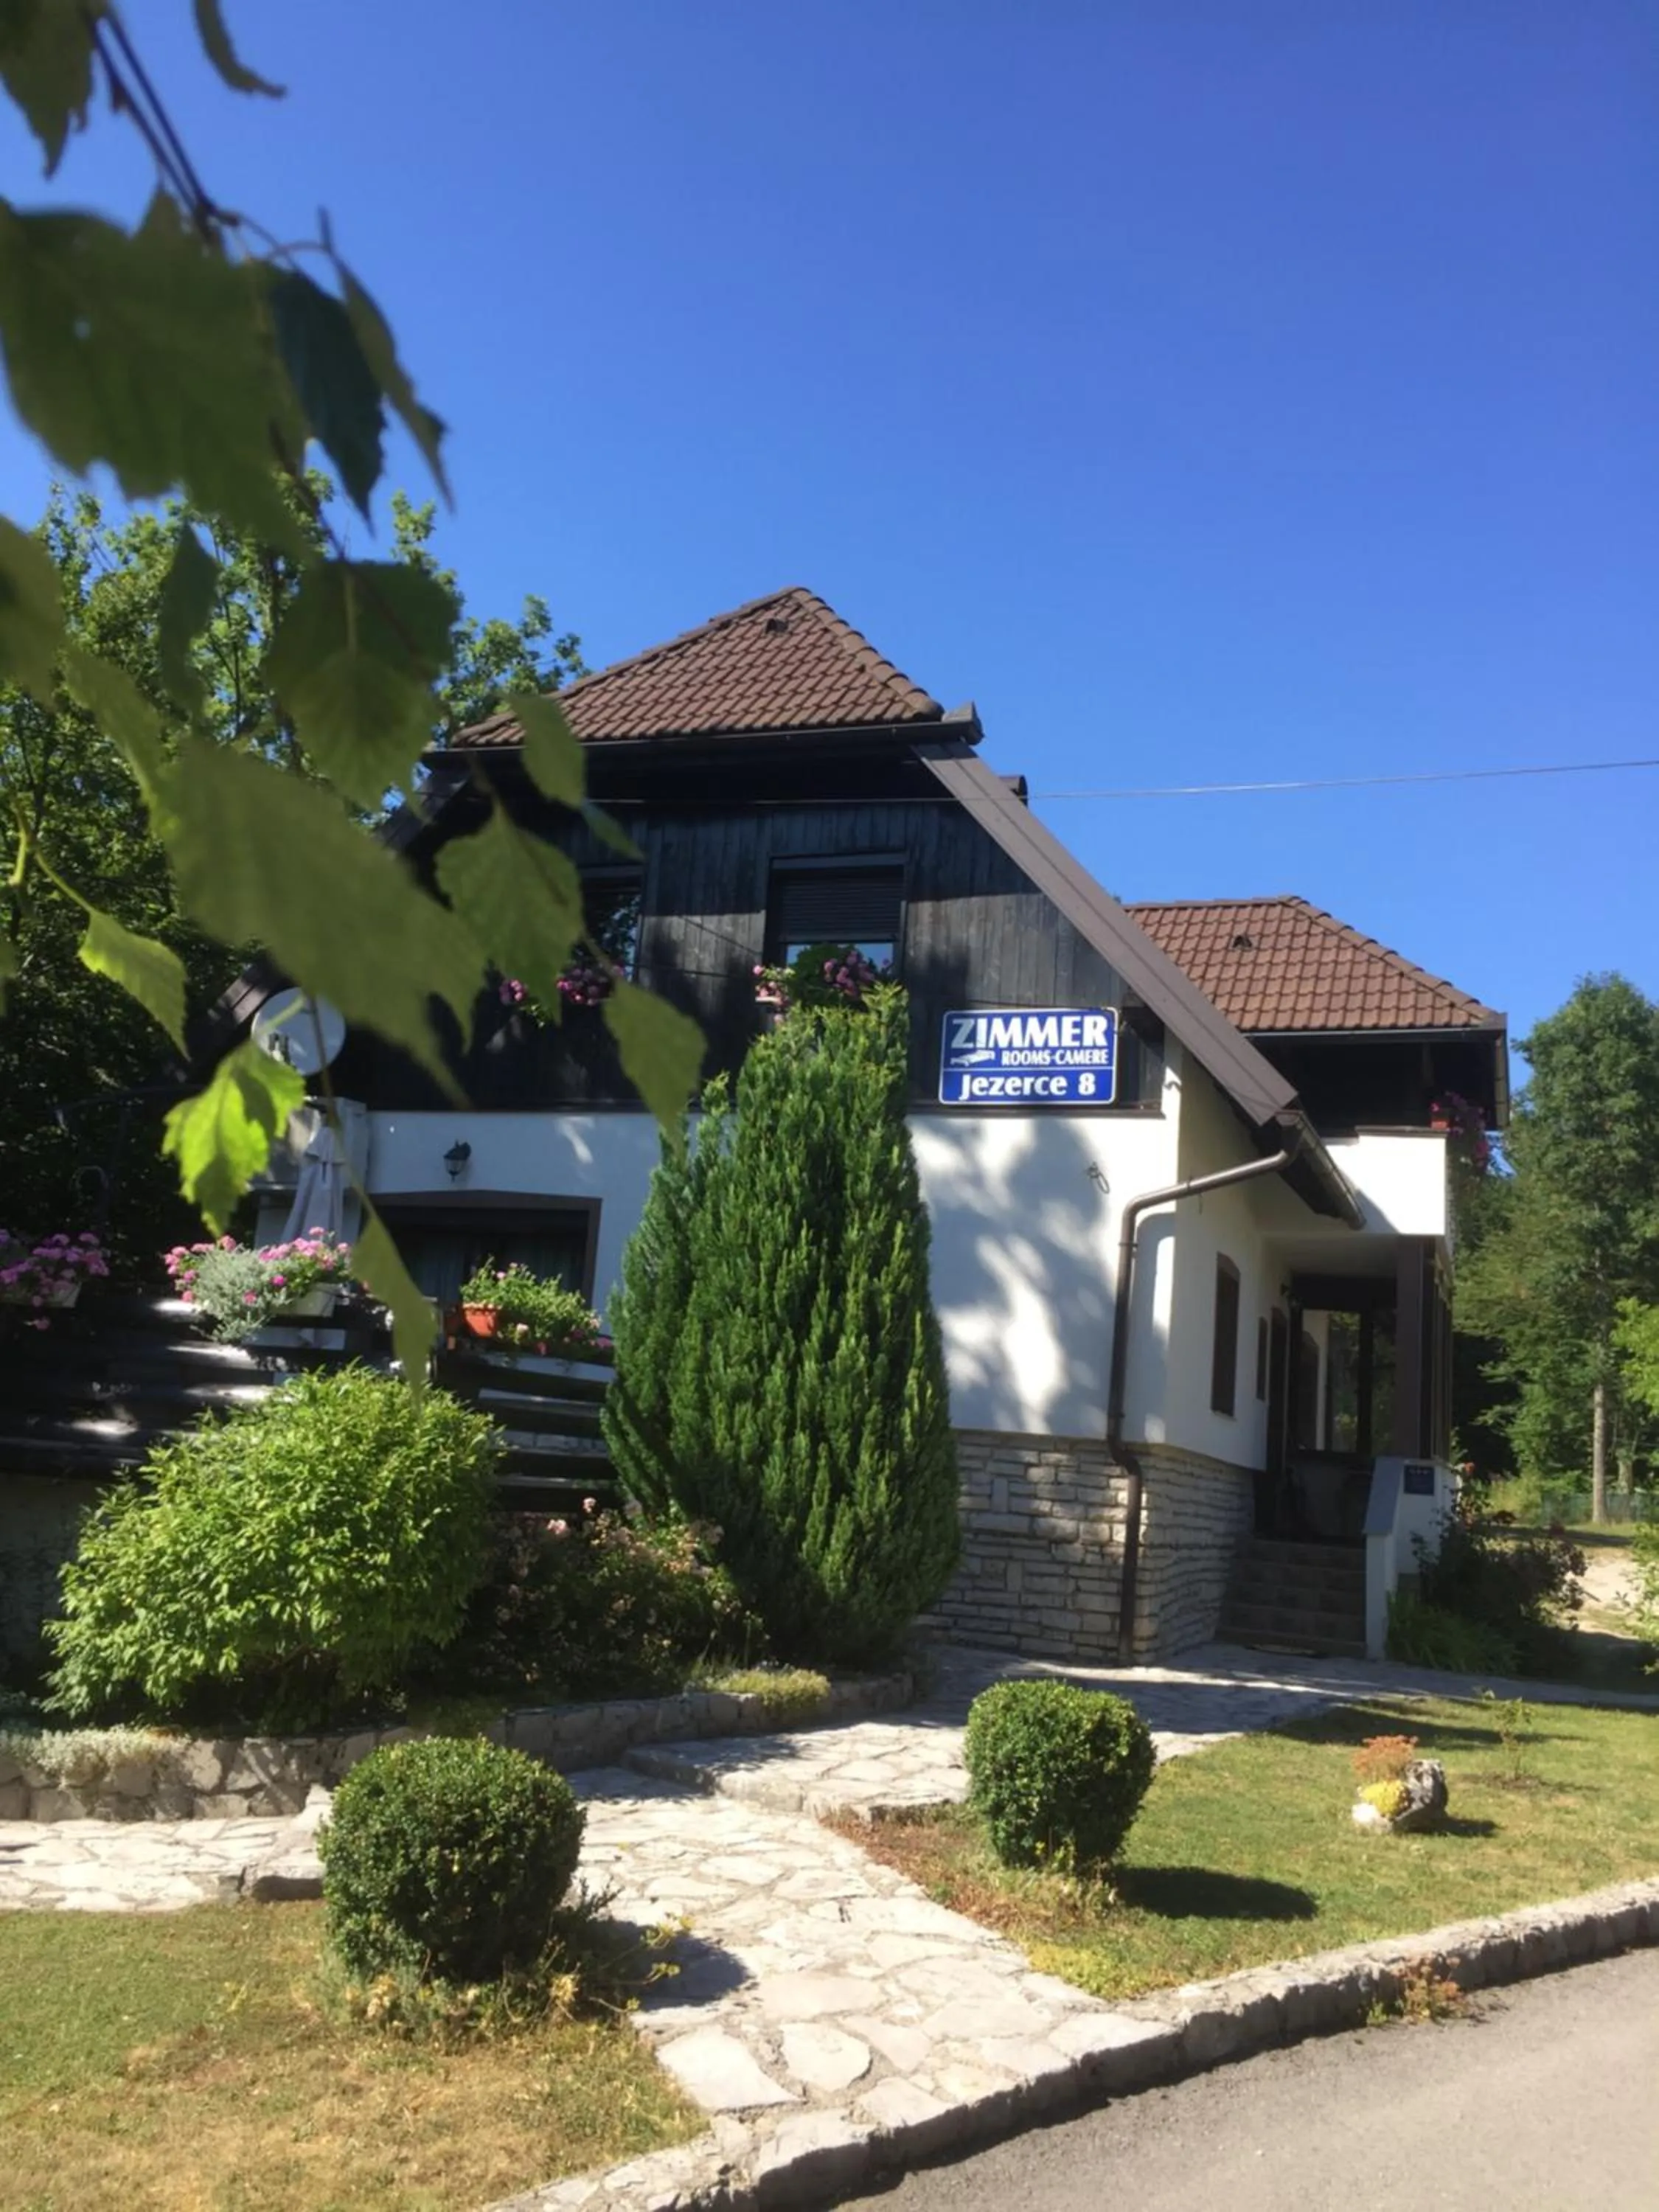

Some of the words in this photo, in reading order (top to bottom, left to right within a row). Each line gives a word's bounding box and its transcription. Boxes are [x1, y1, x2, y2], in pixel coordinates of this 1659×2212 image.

[951, 1015, 1108, 1048] ZIMMER
[959, 1074, 1068, 1101] Jezerce
[1078, 1073, 1096, 1096] 8
